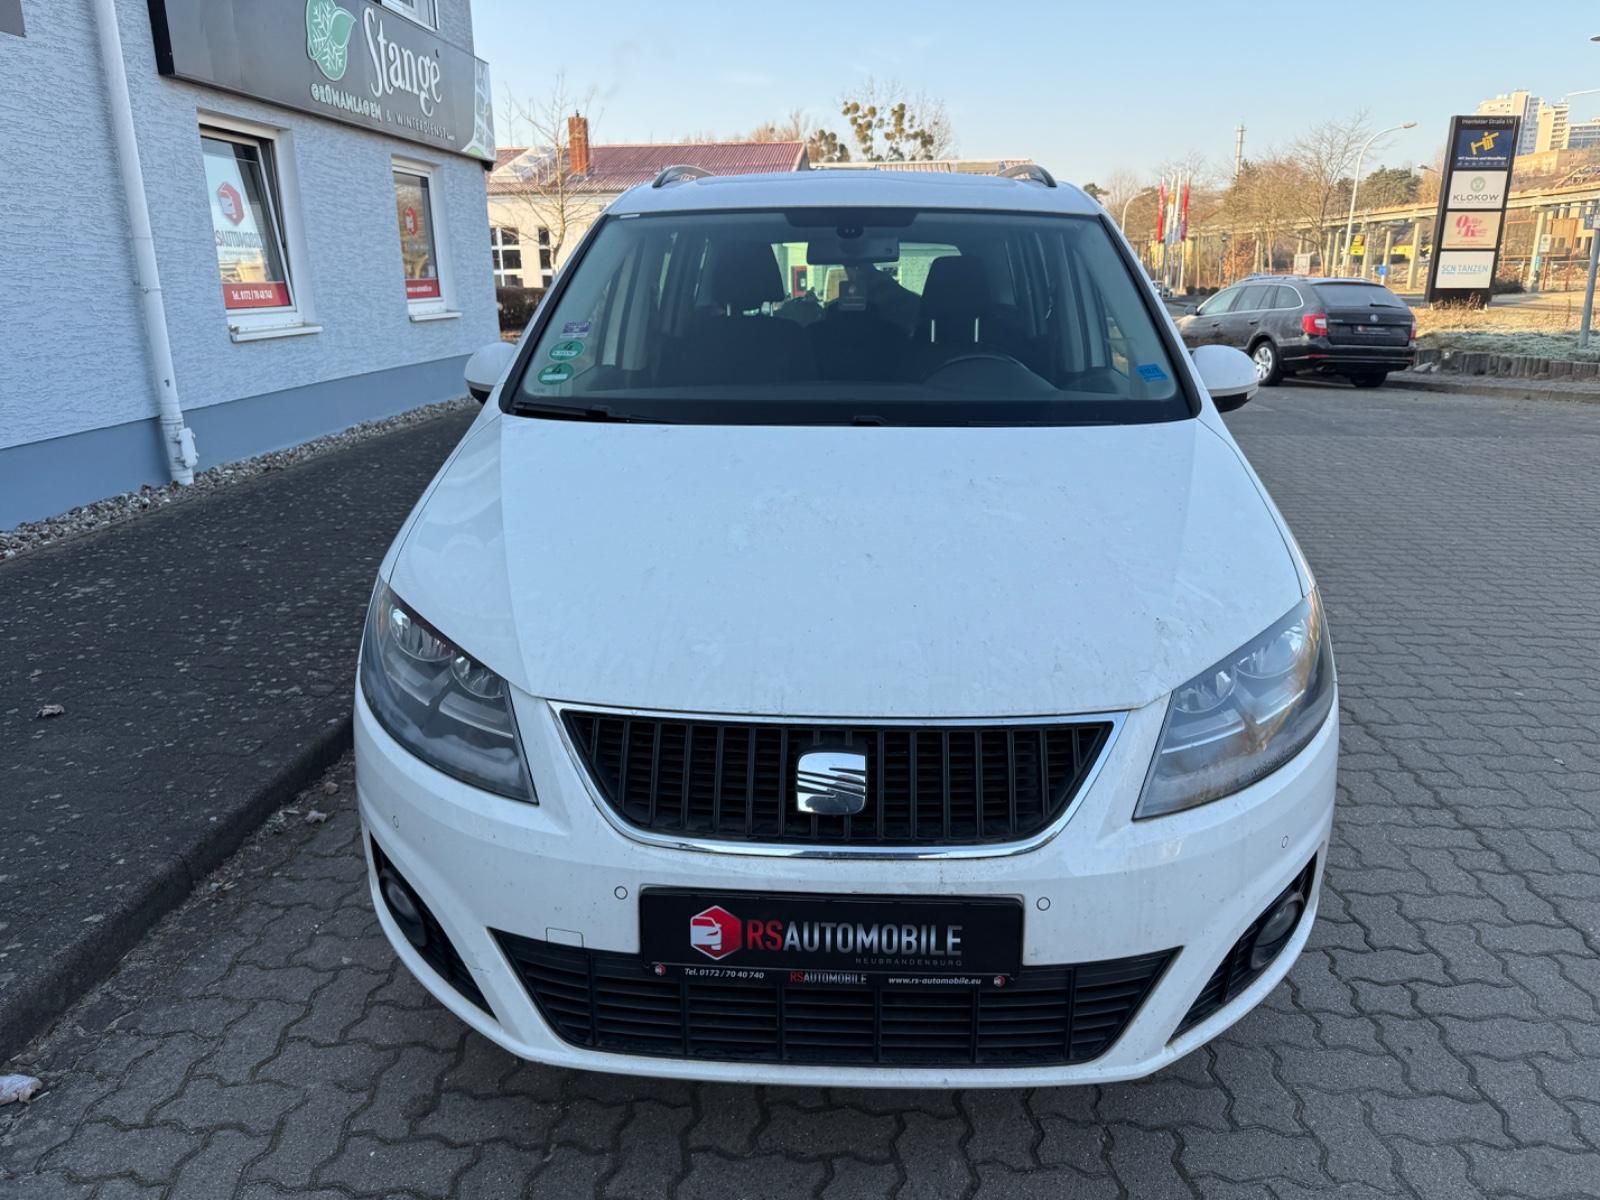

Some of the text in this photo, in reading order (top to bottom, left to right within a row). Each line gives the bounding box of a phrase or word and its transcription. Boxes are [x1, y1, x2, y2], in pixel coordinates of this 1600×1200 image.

[363, 7, 442, 117] Stange
[395, 113, 447, 139] WINTERDIENST
[1453, 194, 1499, 202] KLOKOW
[1457, 264, 1489, 273] TANZEN
[746, 919, 963, 956] RSAUTOMOBILE
[855, 957, 962, 967] NEUBRANDENBURG
[684, 967, 698, 976] Tel.
[699, 969, 720, 977] 0172
[726, 970, 736, 978] 70
[737, 970, 748, 979] 40
[749, 971, 765, 980] 740
[790, 970, 867, 985] RSAUTOMOBILE
[888, 976, 982, 986] www.rs-automobile.eu
